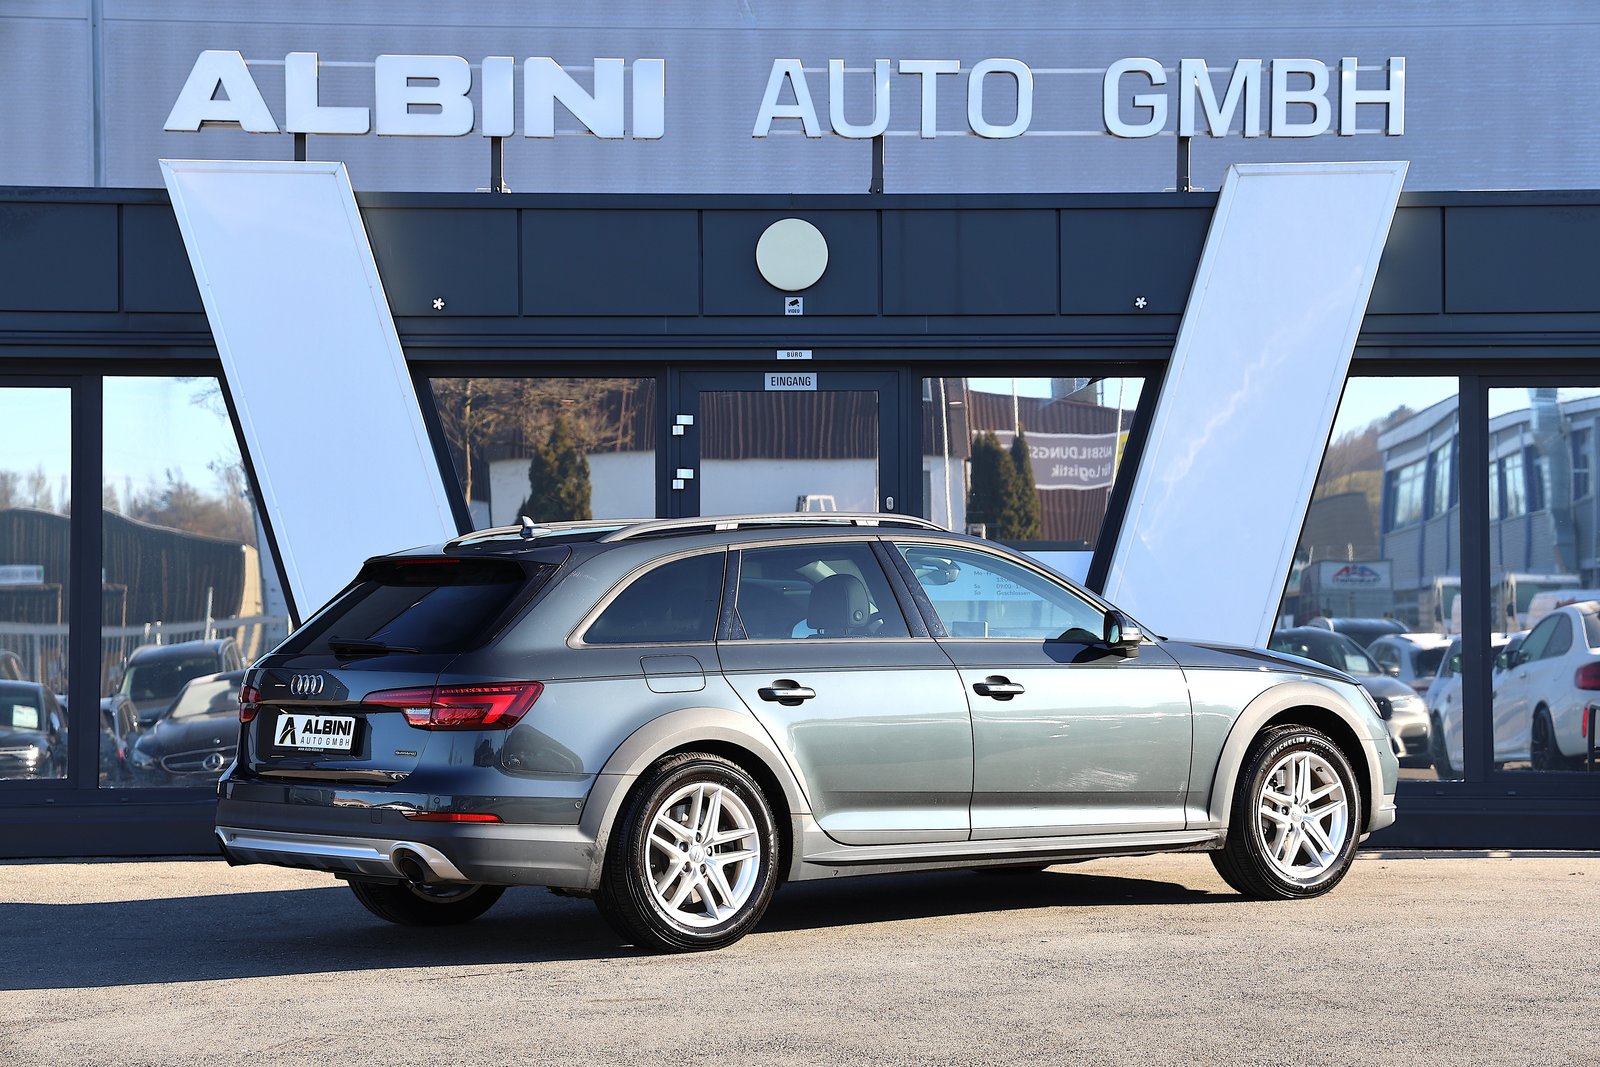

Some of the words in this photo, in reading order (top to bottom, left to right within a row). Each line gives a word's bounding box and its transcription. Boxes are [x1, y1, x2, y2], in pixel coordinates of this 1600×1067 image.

[163, 50, 665, 140] ALBINI
[752, 57, 1033, 139] AUTO
[1103, 56, 1406, 139] GMBH
[771, 376, 811, 386] EINGANG
[302, 719, 352, 736] ALBINI
[300, 736, 323, 746] AUTO
[325, 737, 351, 747] GMBH
[1270, 736, 1306, 759] MICHELIN
